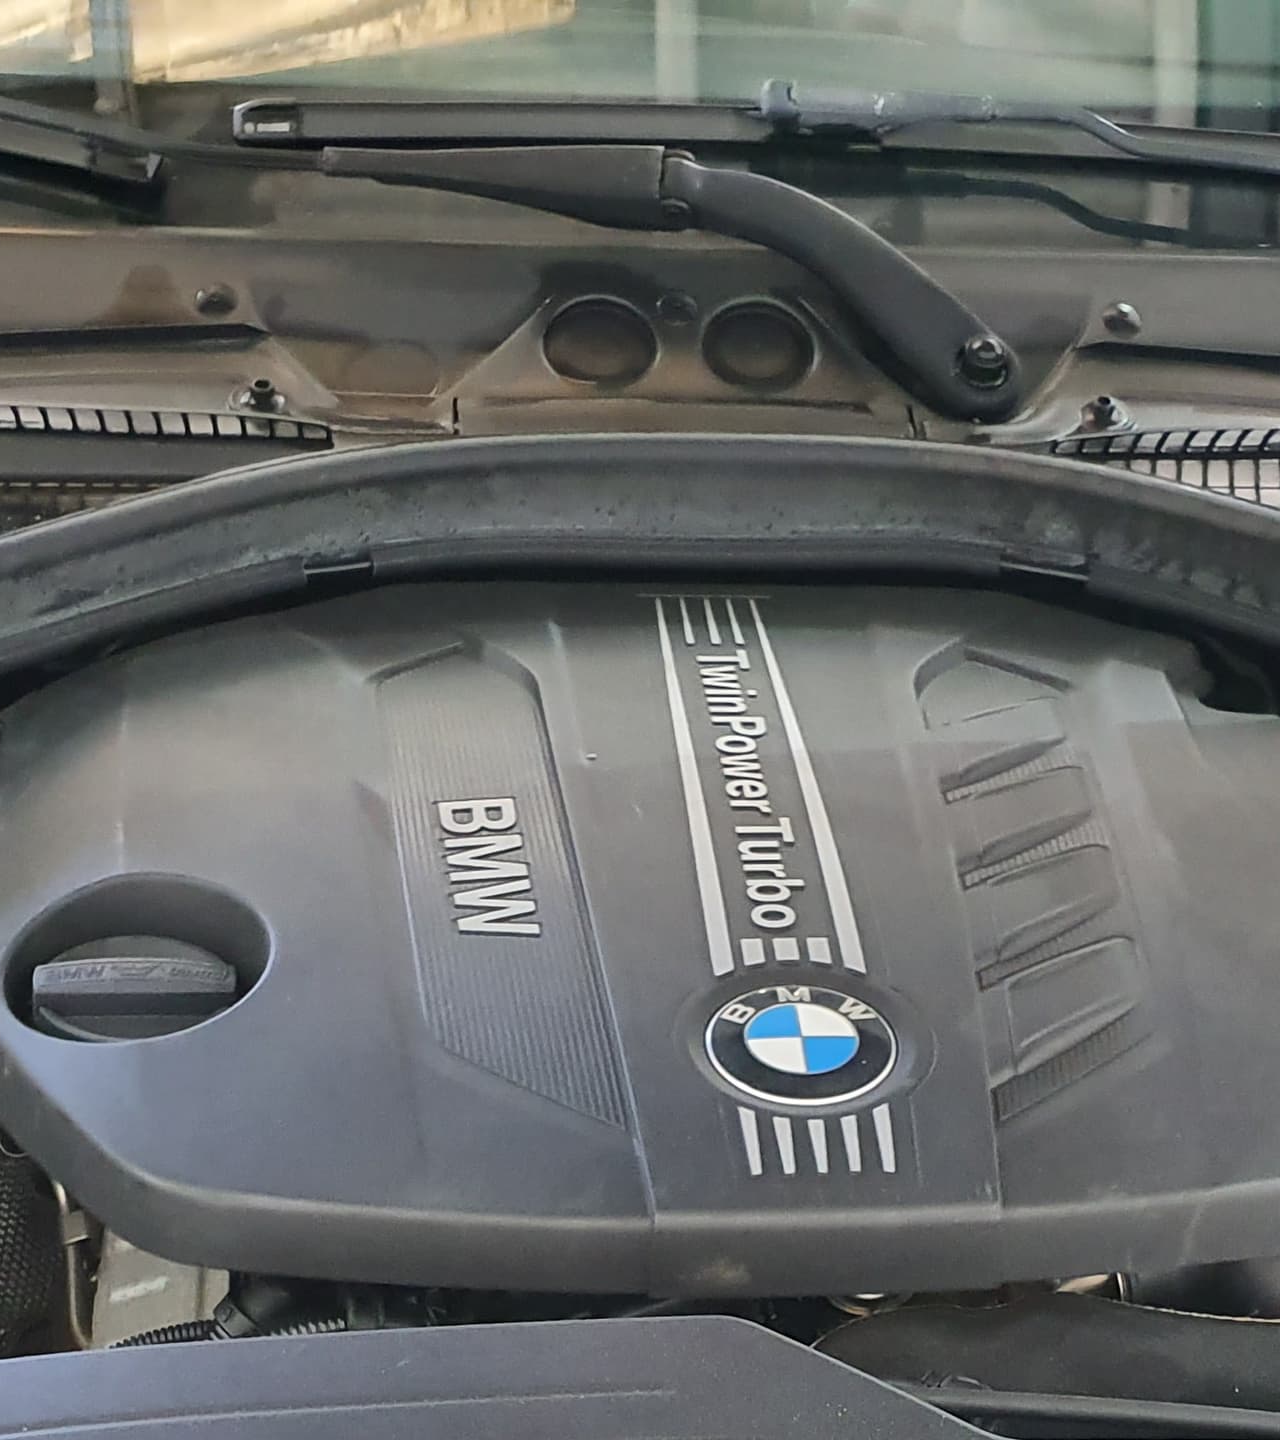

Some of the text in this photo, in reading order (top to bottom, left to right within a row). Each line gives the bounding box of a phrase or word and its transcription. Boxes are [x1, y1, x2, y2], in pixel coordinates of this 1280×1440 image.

[695, 649, 806, 928] TwinPower Turbo
[436, 797, 542, 936] BMW
[719, 985, 877, 1025] BMW
